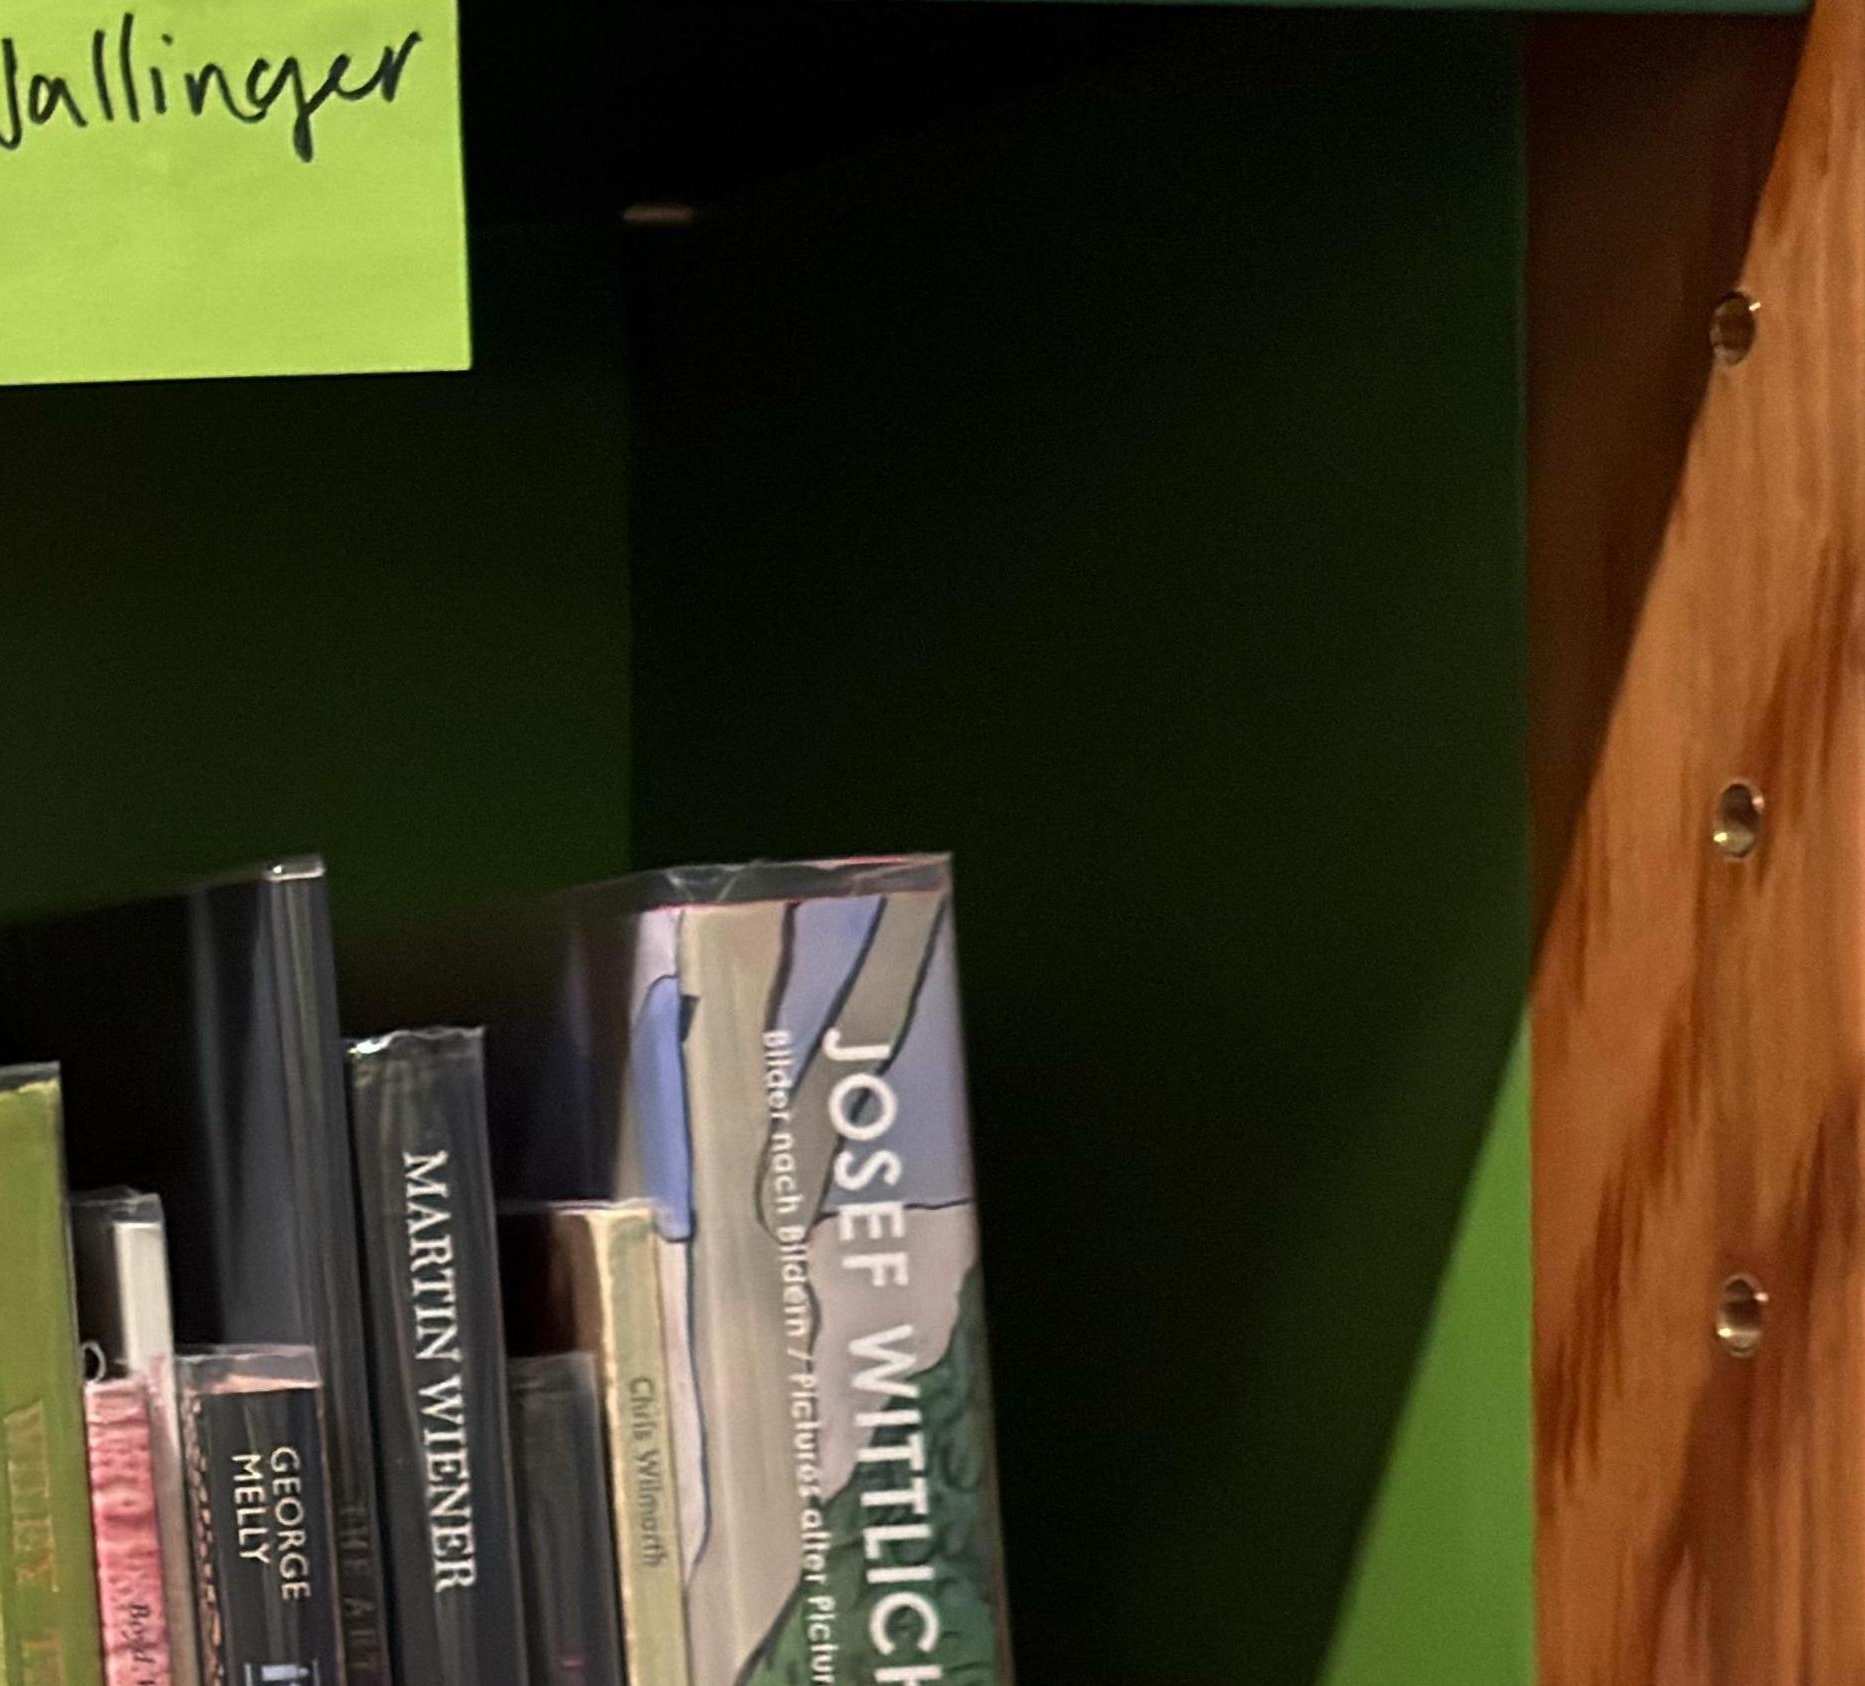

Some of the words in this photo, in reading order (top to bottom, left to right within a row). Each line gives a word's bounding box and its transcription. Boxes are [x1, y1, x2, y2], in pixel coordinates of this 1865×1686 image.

[760, 1028, 795, 1123] Bilder
[772, 1131, 806, 1216] nach
[819, 1026, 912, 1289] JOSEF
[401, 1149, 465, 1362] MARTIN
[777, 1225, 814, 1338] Bildern
[627, 1376, 658, 1442] Chris
[788, 1371, 824, 1502] Pictures
[230, 1452, 271, 1566] MELLY
[268, 1446, 311, 1603] GEORGE
[418, 1376, 479, 1594] WIENER
[636, 1449, 668, 1569] Wilmarth
[799, 1507, 831, 1586] after
